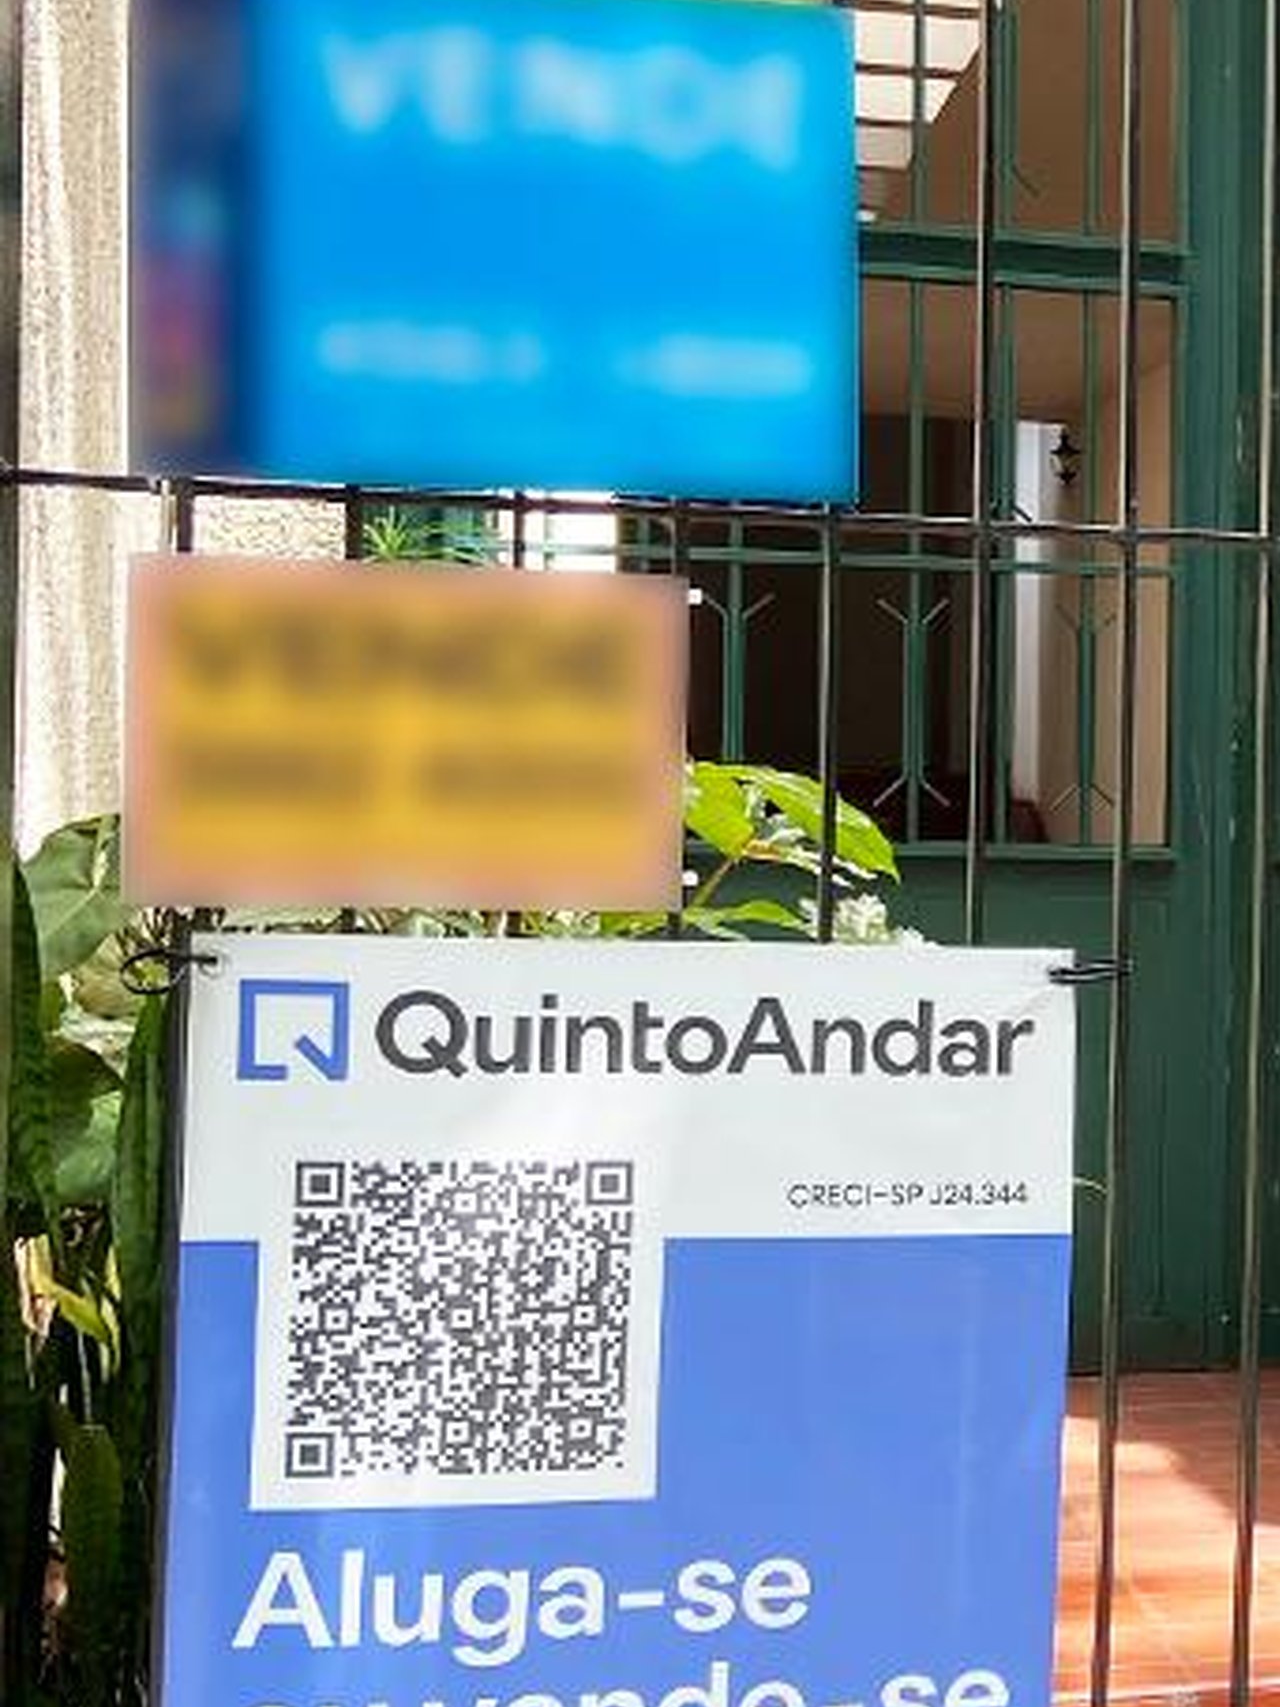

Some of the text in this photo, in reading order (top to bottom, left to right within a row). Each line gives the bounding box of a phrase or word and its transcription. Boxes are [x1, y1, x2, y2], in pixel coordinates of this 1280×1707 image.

[374, 988, 1035, 1080] QuintoAndar
[787, 1180, 1028, 1208] CRECI-SP J24.344
[231, 1549, 812, 1667] Aluga-se
